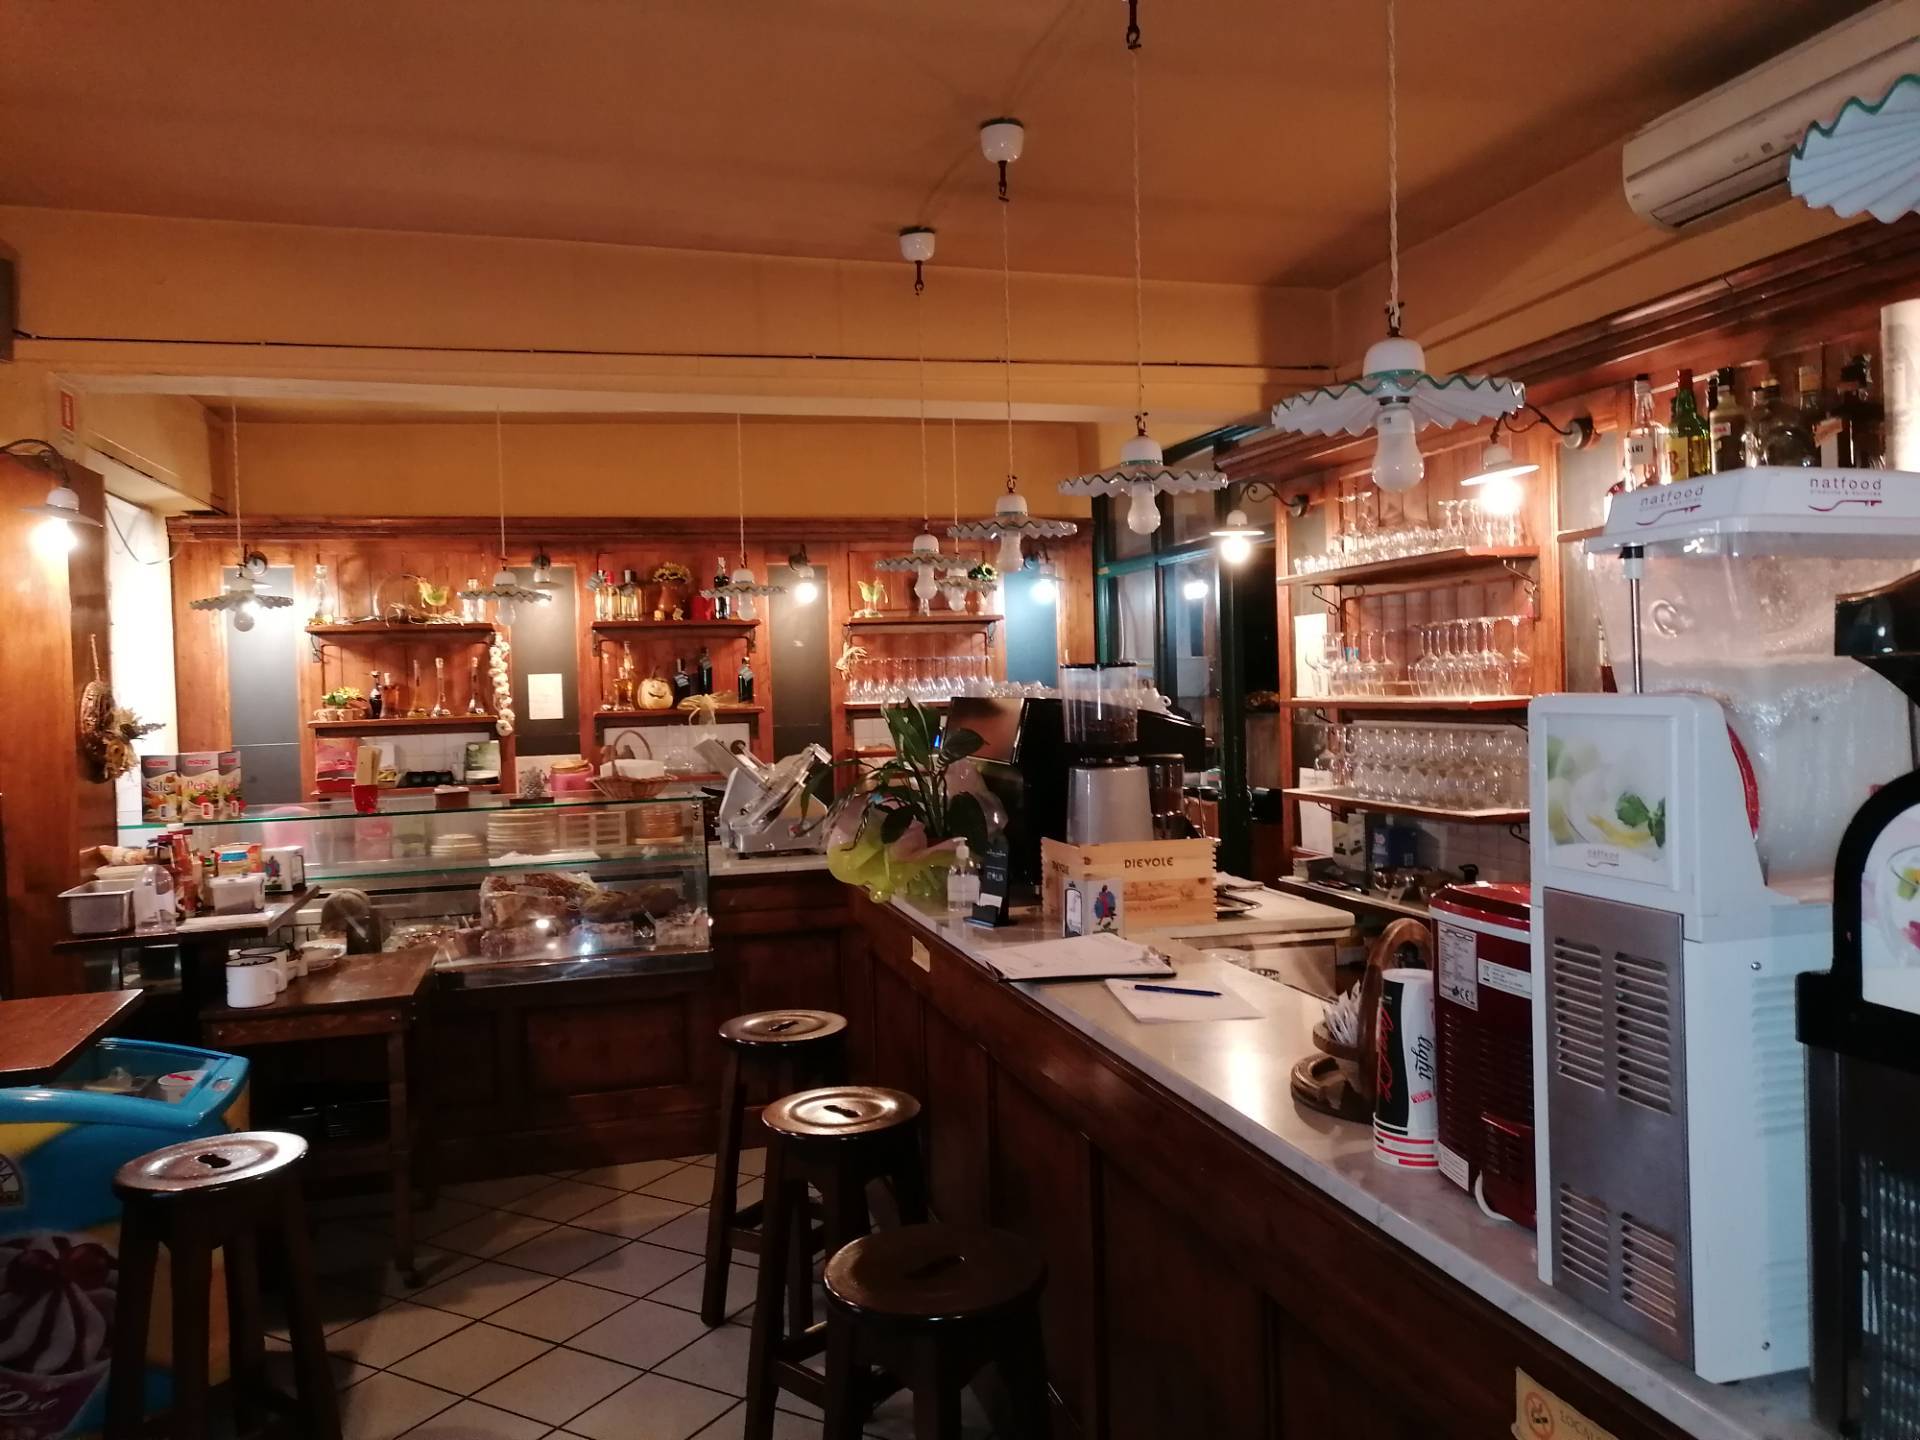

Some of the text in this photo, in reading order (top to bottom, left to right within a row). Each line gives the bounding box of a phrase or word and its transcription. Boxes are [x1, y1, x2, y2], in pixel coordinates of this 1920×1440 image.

[1810, 477, 1882, 491] natfood
[1640, 485, 1704, 507] natfood
[146, 781, 170, 792] Sale
[1124, 856, 1174, 869] DIEVOLE
[1411, 1035, 1434, 1081] light
